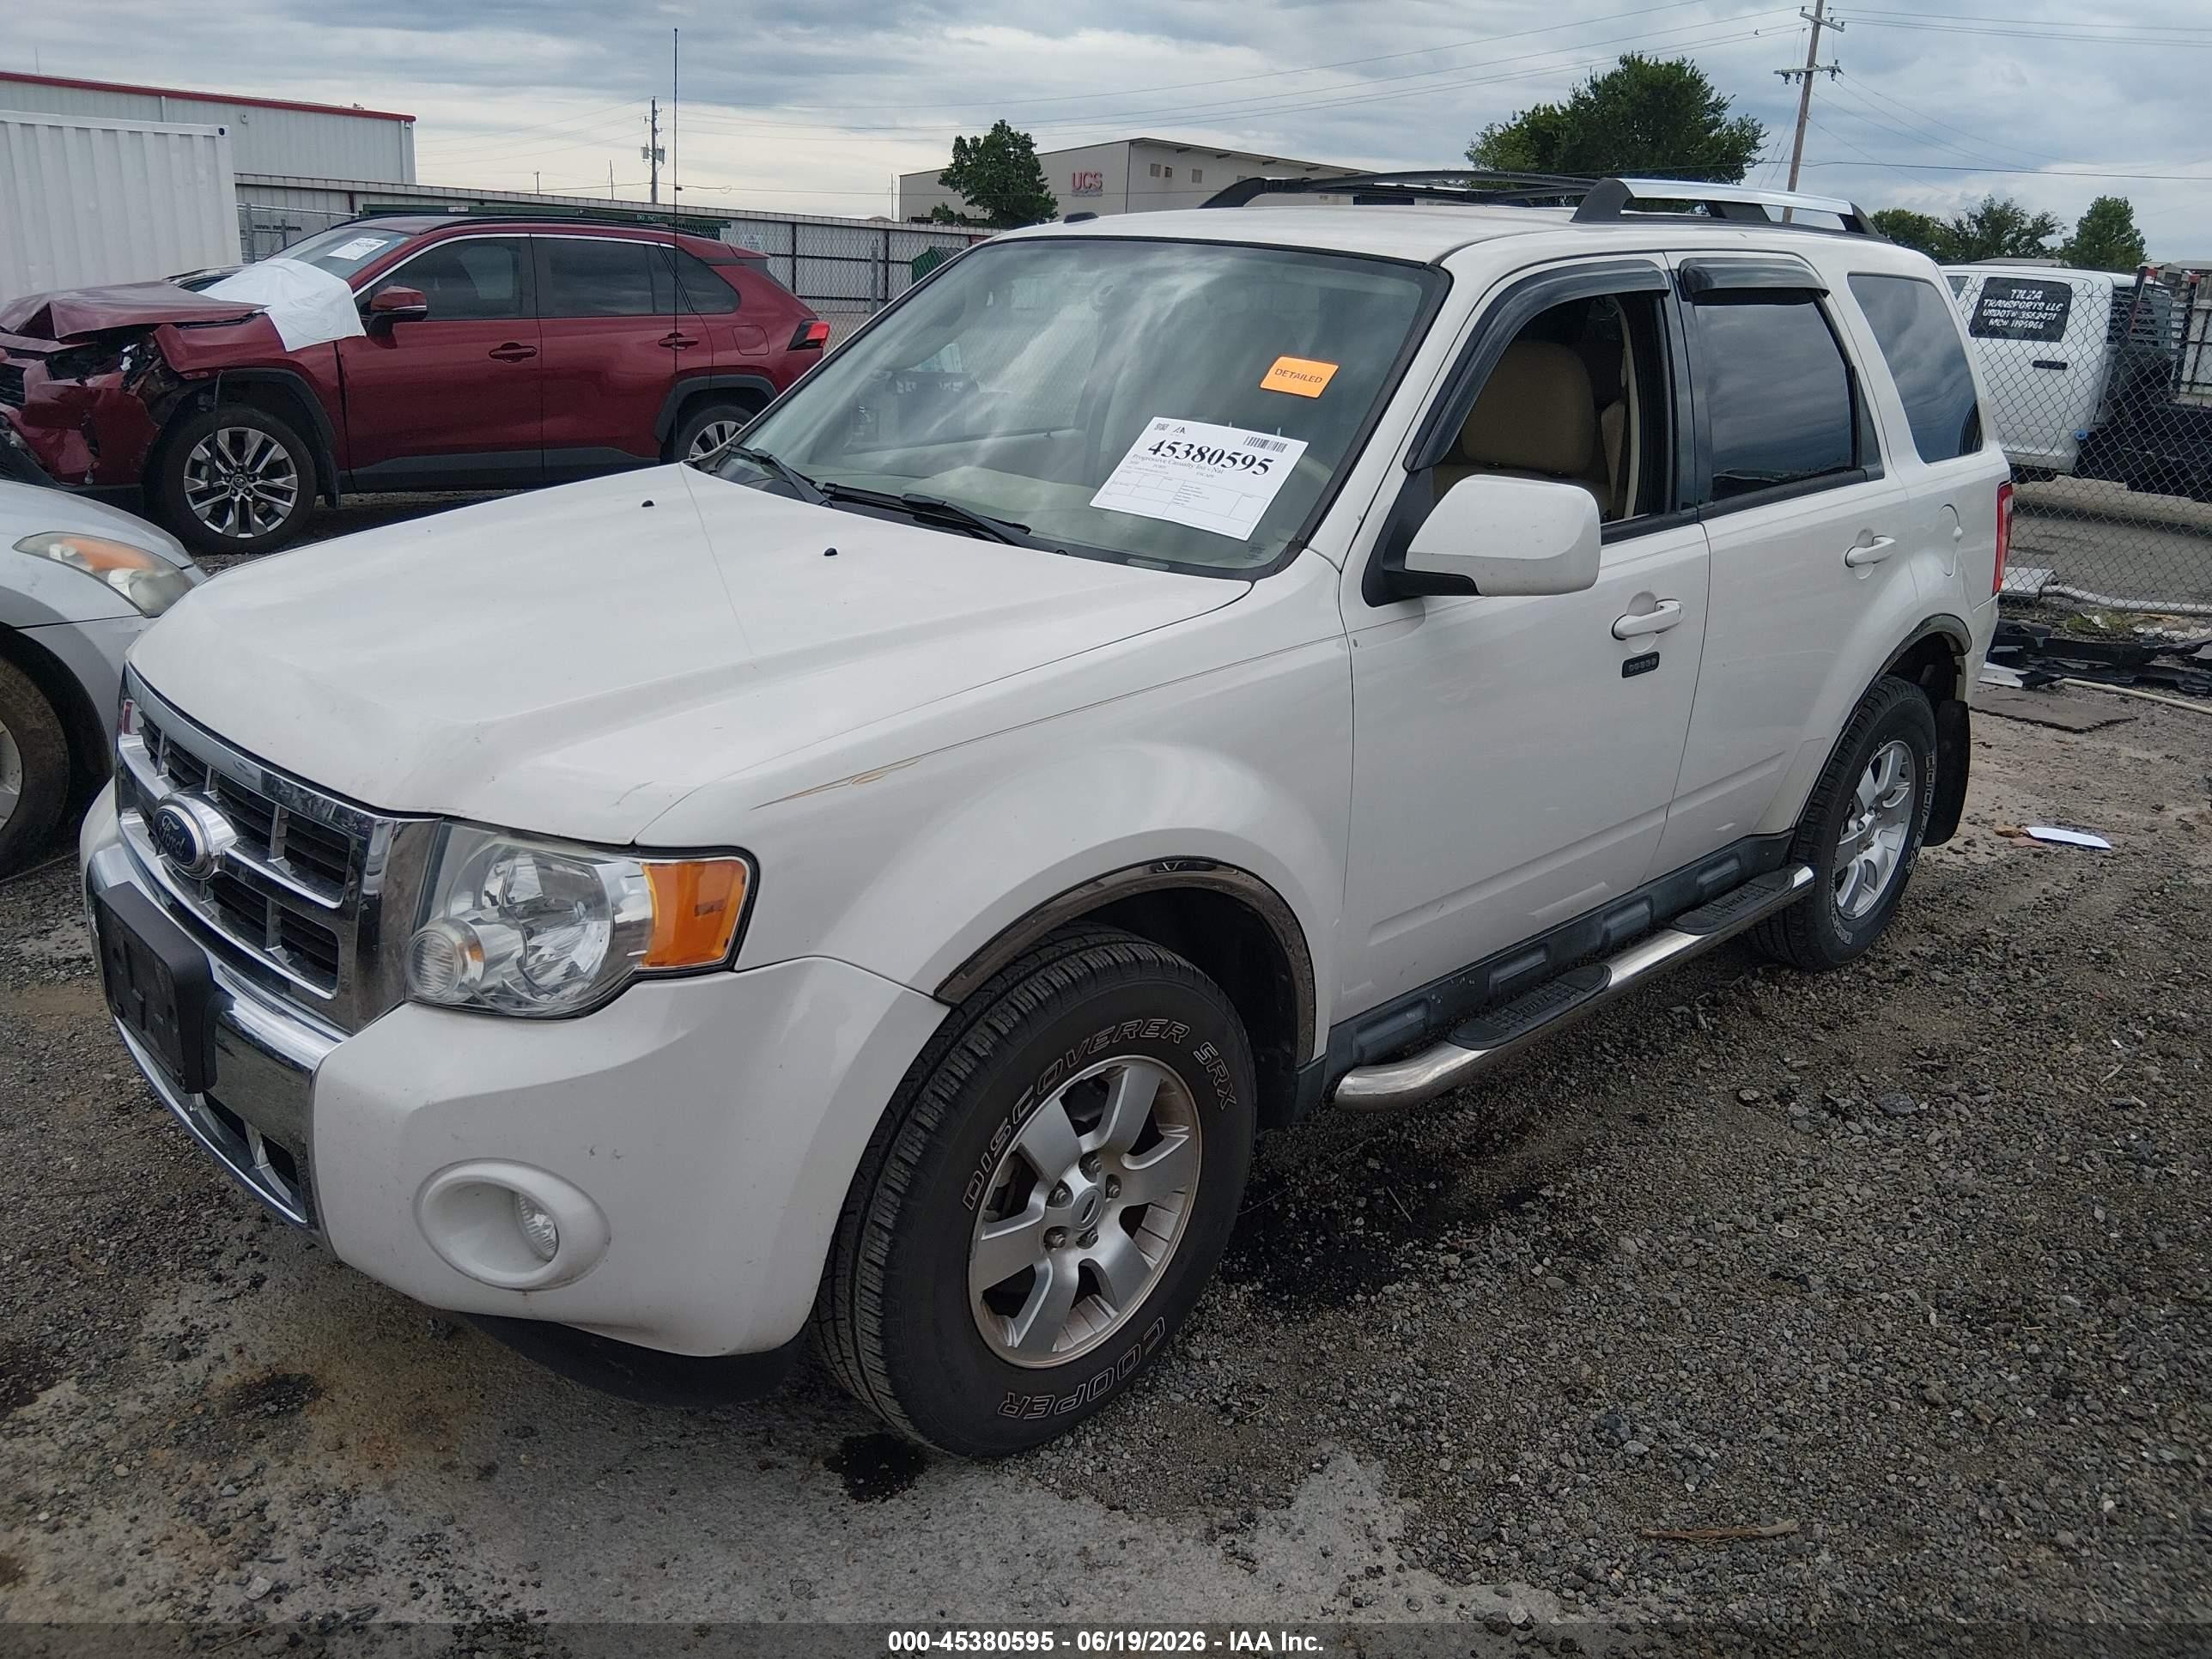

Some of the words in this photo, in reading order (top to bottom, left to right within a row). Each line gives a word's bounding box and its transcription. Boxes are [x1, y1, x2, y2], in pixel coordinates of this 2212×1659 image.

[1072, 171, 1103, 191] UCS
[2010, 289, 2044, 301] TILZA
[1983, 299, 2045, 310] TRANSPORTS
[2045, 302, 2064, 312] LLC
[1274, 368, 1323, 385] DETAILED
[1147, 439, 1274, 476] 45380595
[962, 1018, 1190, 1212] DISCOVERER
[1193, 1041, 1237, 1110] SRX
[997, 1316, 1165, 1420] COOPER
